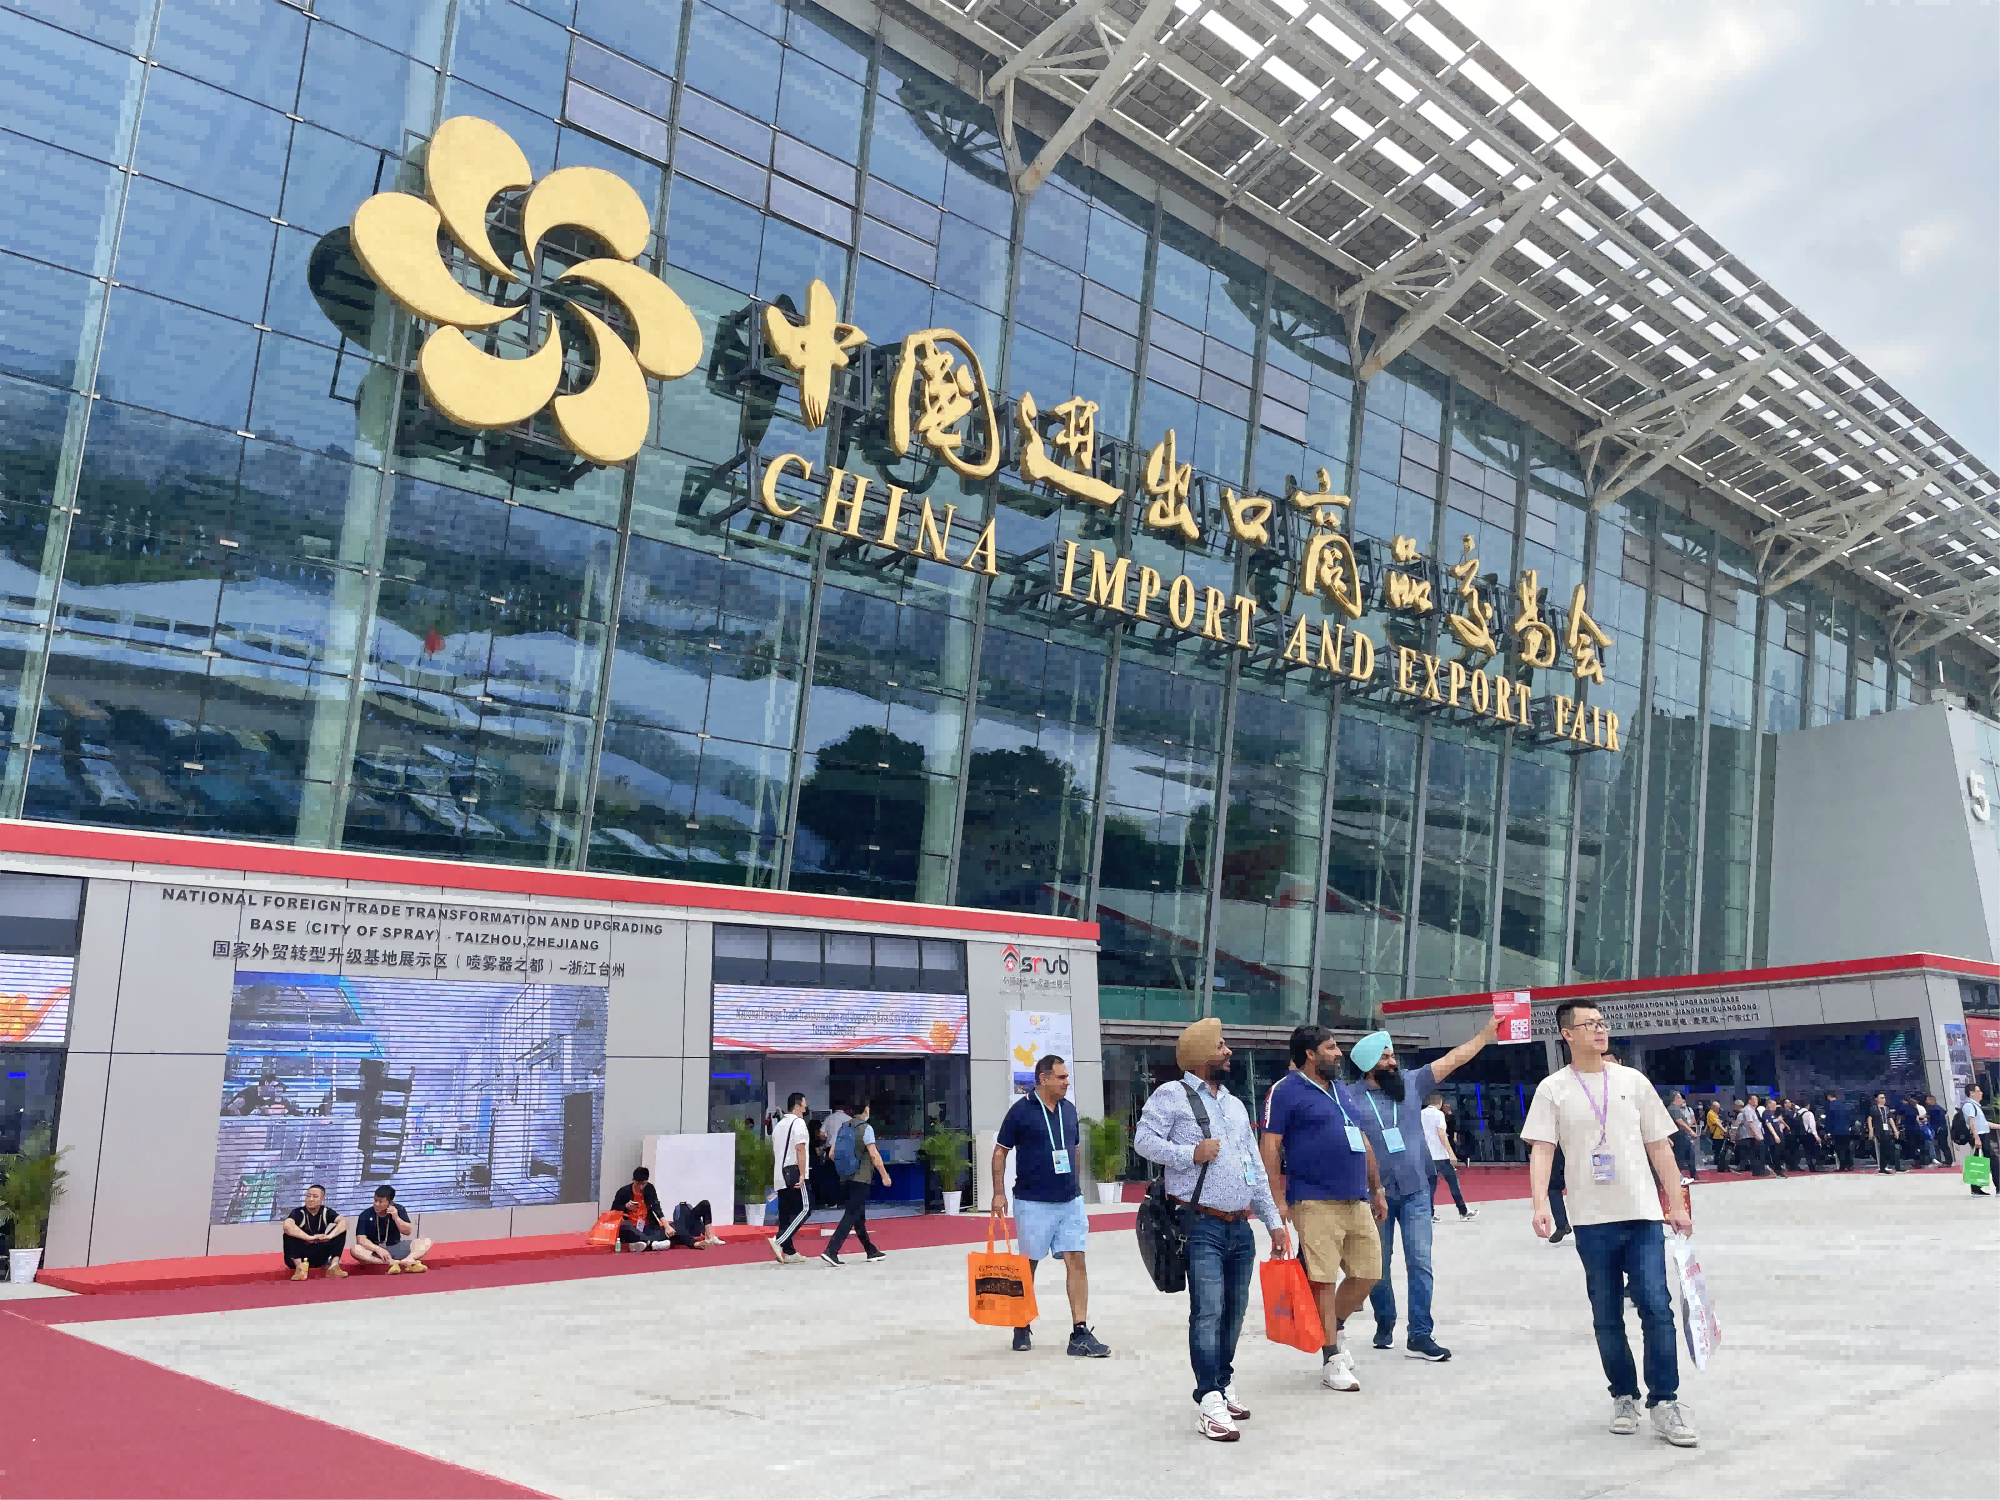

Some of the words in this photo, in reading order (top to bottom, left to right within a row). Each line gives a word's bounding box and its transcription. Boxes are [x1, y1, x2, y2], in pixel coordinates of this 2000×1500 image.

[760, 453, 1000, 576] CHINA
[1058, 540, 1257, 650] IMPORT
[1283, 613, 1376, 682] AND
[1396, 645, 1533, 727] EXPORT
[1553, 694, 1621, 752] FAIR
[162, 888, 257, 907] NATIONAL
[263, 895, 342, 912] FOREIGN
[346, 902, 401, 916] TRADE
[405, 906, 547, 927] TRANSFORMATION
[550, 917, 580, 928] AND
[583, 919, 663, 935] UPGRADING
[250, 918, 297, 932] BASE
[356, 925, 378, 937] OF
[1607, 1001, 1664, 1012] TRANSFORMATION
[1680, 996, 1720, 1006] UPGRADING
[1720, 995, 1740, 1003] BASE
